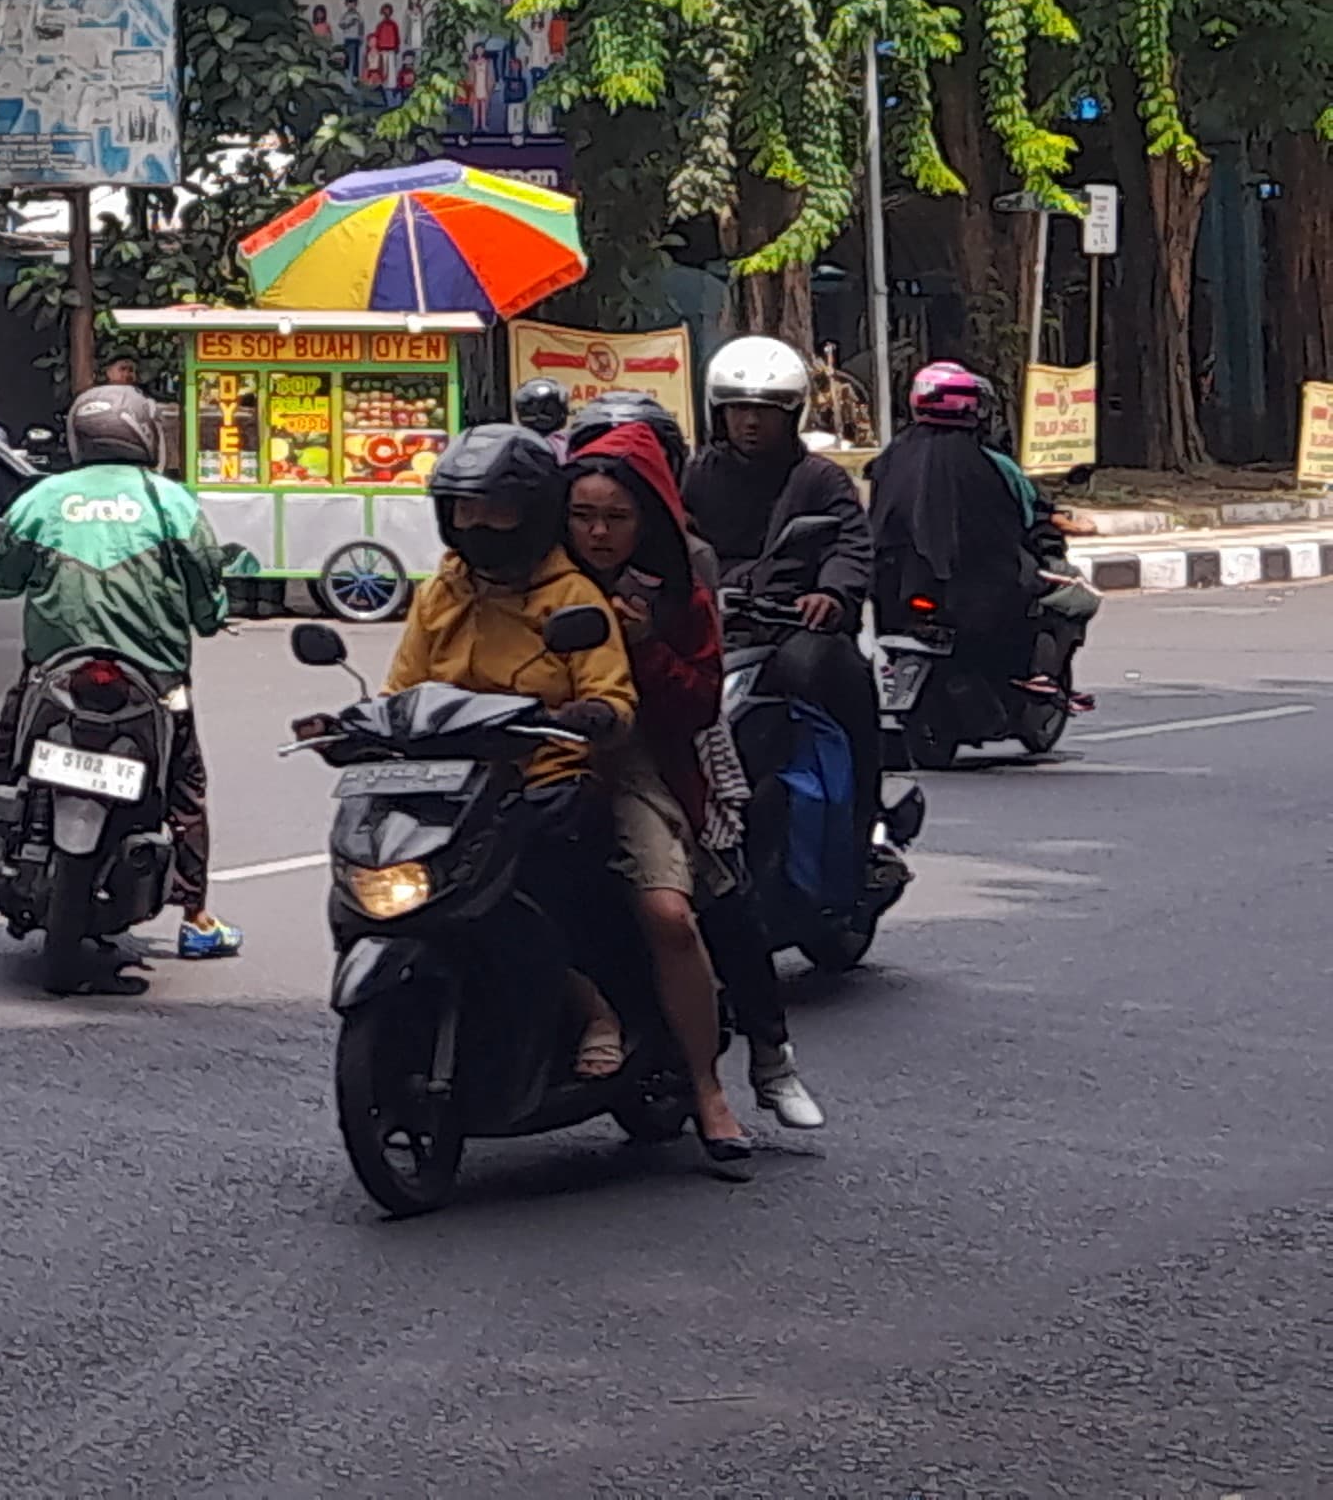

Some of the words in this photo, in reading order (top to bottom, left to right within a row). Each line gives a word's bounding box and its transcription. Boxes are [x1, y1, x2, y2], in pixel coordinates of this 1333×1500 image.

[240, 333, 286, 357] SOP
[293, 332, 354, 358] BUAH
[376, 335, 440, 359] OYEN
[220, 375, 240, 481] OYEN
[62, 493, 141, 523] Grab
